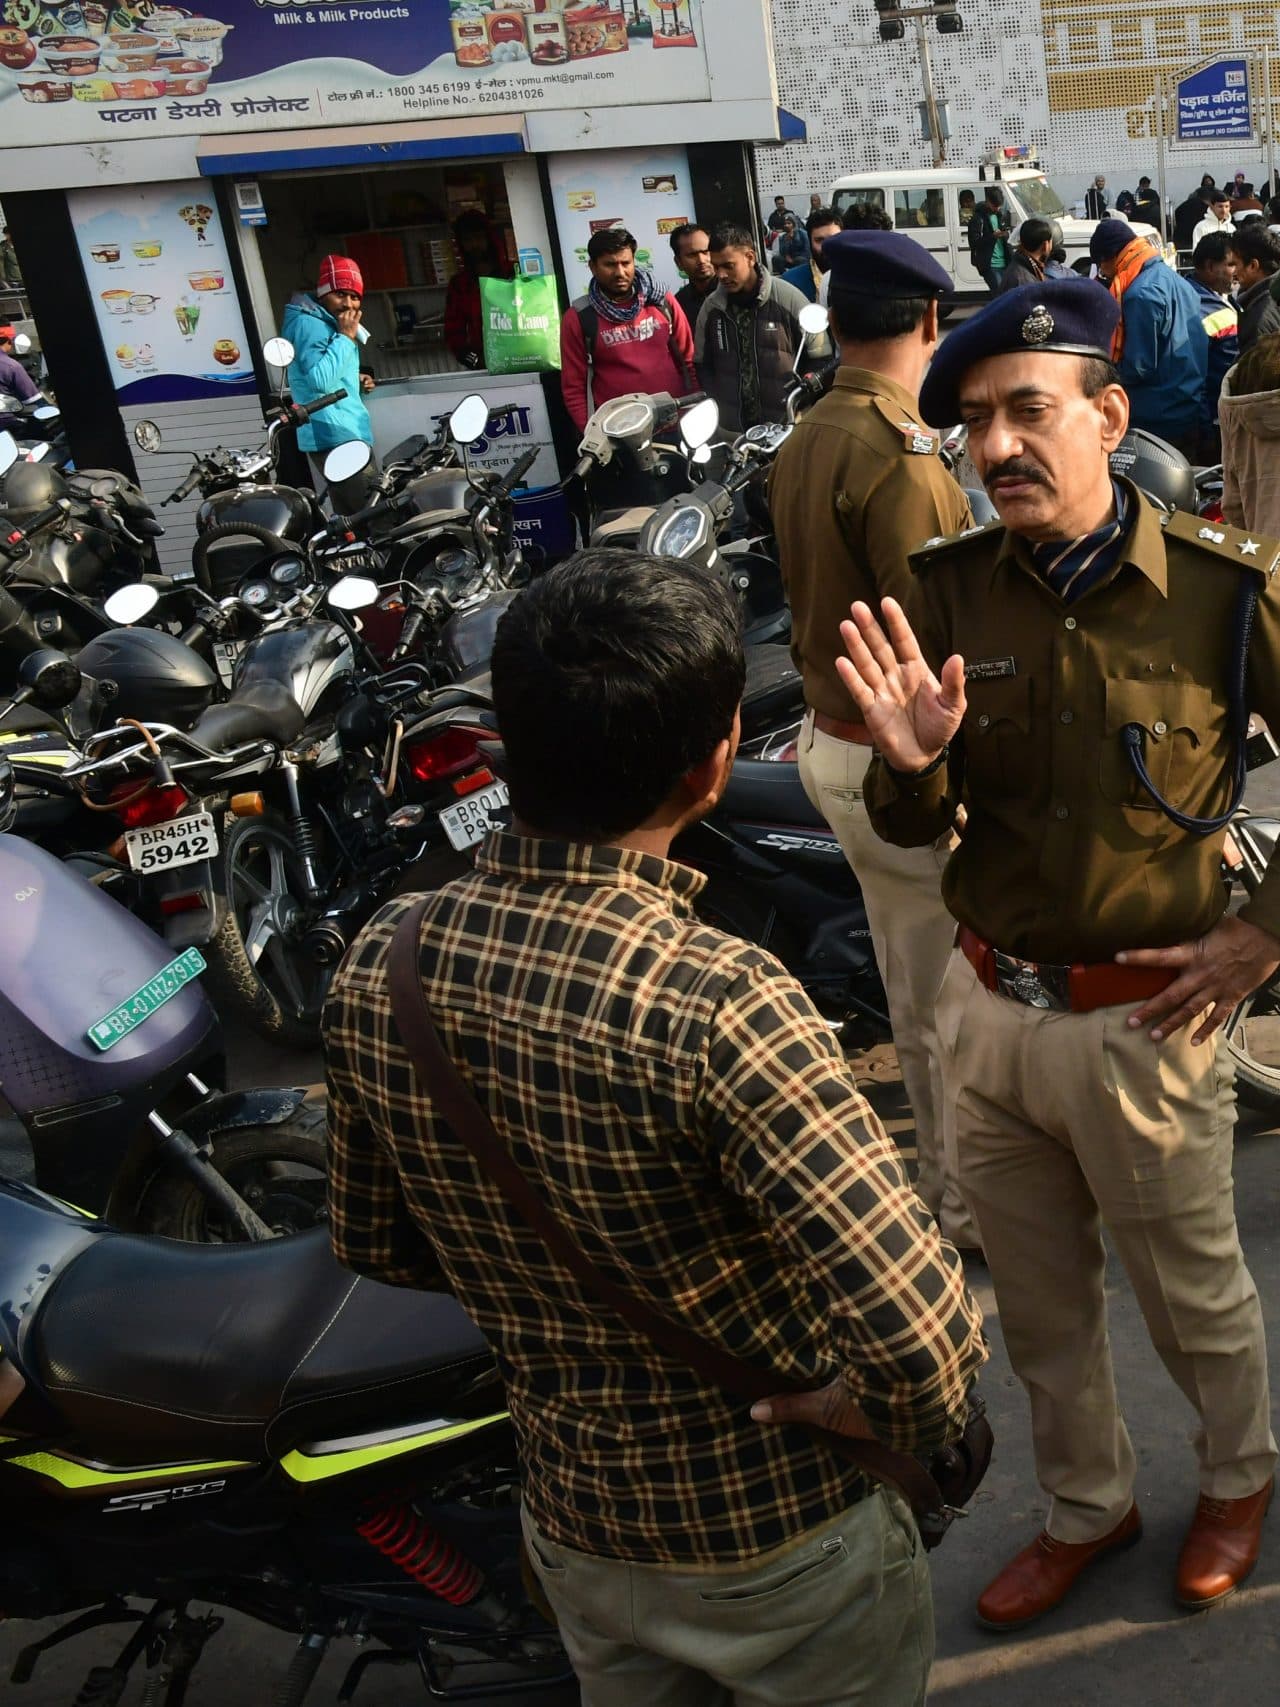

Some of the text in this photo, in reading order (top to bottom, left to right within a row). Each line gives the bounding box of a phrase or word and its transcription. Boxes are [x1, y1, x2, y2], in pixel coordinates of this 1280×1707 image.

[274, 6, 410, 25] Milk & Milk Products
[327, 91, 347, 101] टोल
[349, 90, 363, 100] फ्री
[388, 86, 415, 97] 1800
[418, 84, 440, 94] 345
[443, 81, 470, 92] 6199
[515, 70, 615, 87] vpmu.mkt@gmail.com
[403, 97, 450, 108] Helpline
[478, 88, 544, 103] 6204381026
[98, 96, 310, 123] पटना डेयरी प्रोजेक्ट
[1180, 89, 1246, 110] पड़ाव वर्जित
[140, 820, 201, 846] BR45H
[140, 836, 210, 868] 5942
